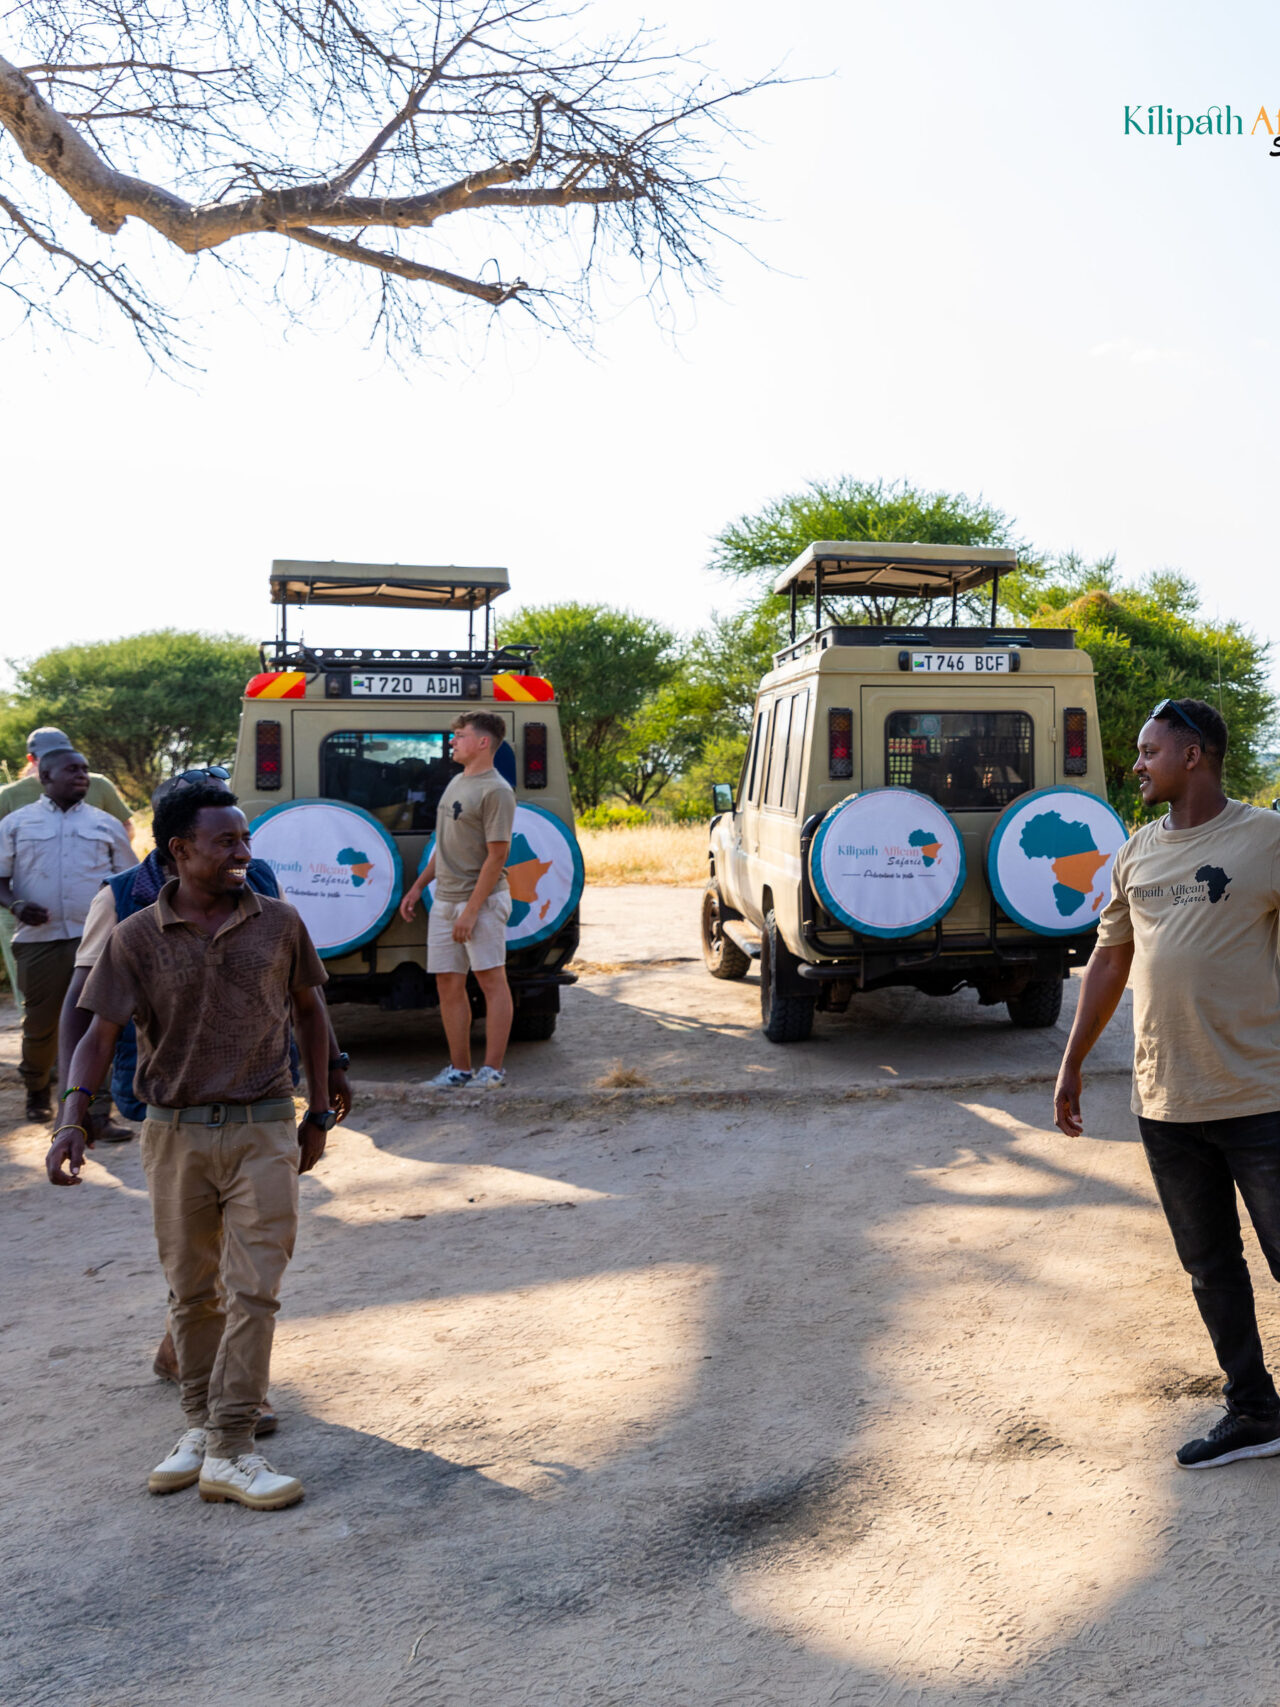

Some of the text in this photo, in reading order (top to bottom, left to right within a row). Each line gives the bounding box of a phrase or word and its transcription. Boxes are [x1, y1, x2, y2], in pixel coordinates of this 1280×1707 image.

[924, 655, 1004, 671] T 746 BCF
[365, 677, 460, 693] T 720 ADH
[838, 845, 878, 859] Kilipath
[887, 857, 921, 867] Safaris
[312, 874, 350, 886] Safaris
[1167, 884, 1205, 897] African
[1172, 895, 1206, 906] Safaris
